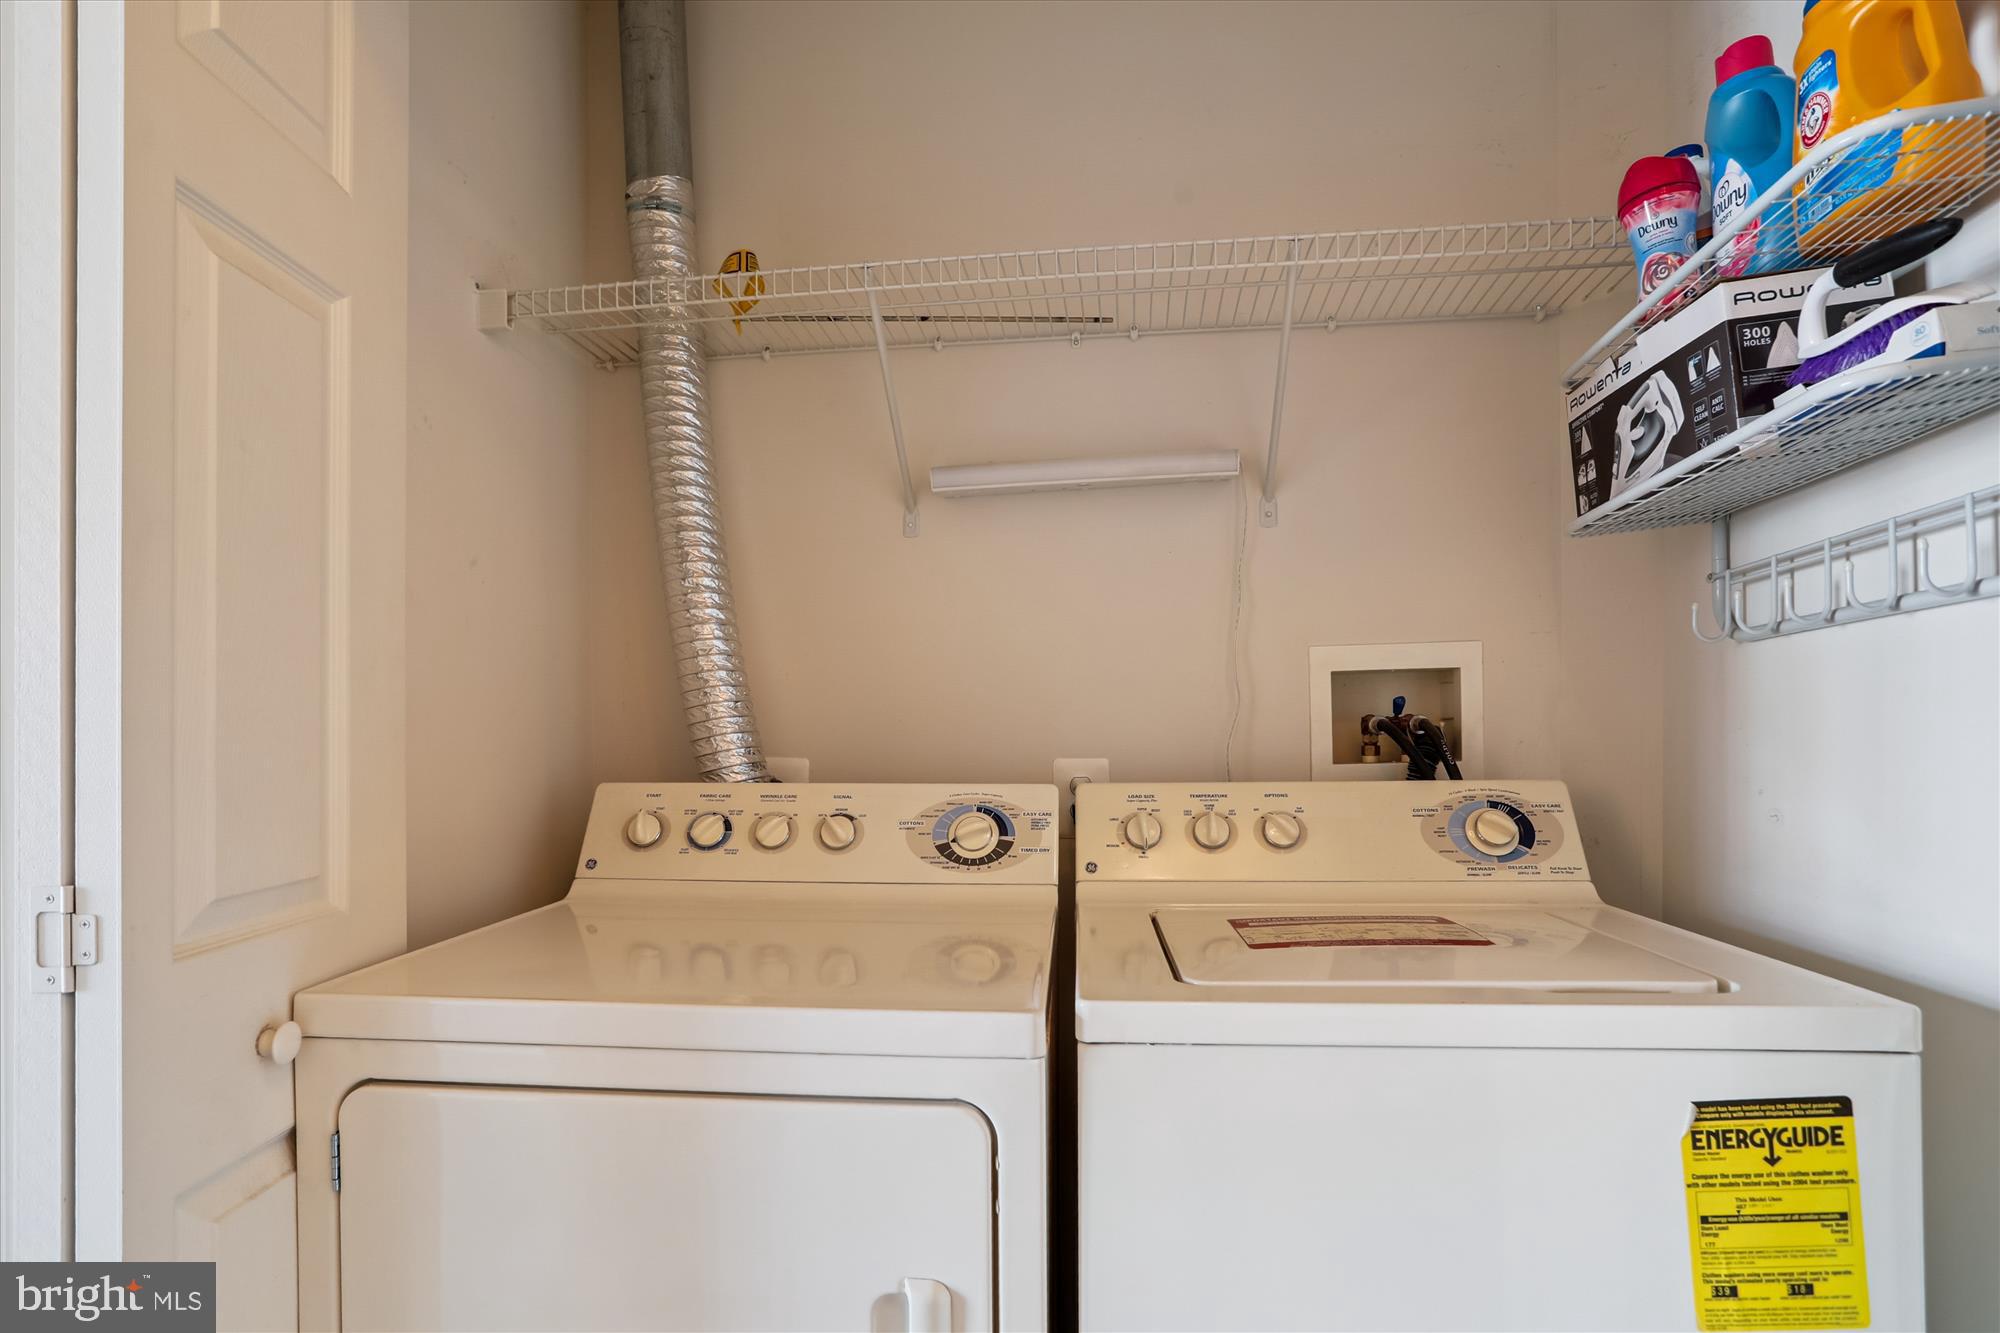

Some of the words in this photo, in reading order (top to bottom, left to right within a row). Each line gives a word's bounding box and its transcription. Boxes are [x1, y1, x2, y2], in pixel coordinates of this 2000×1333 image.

[1808, 95, 1829, 114] HAMMER
[1720, 210, 1732, 226] SOFT
[1637, 216, 1678, 238] Downy
[1742, 326, 1771, 340] 300
[1743, 338, 1772, 348] HOLES
[1712, 395, 1723, 406] ANTI
[1695, 404, 1705, 414] SELF
[1712, 402, 1724, 414] CALC
[1694, 410, 1709, 422] CLEAN
[1691, 1125, 1844, 1150] ENERGYGUIDE
